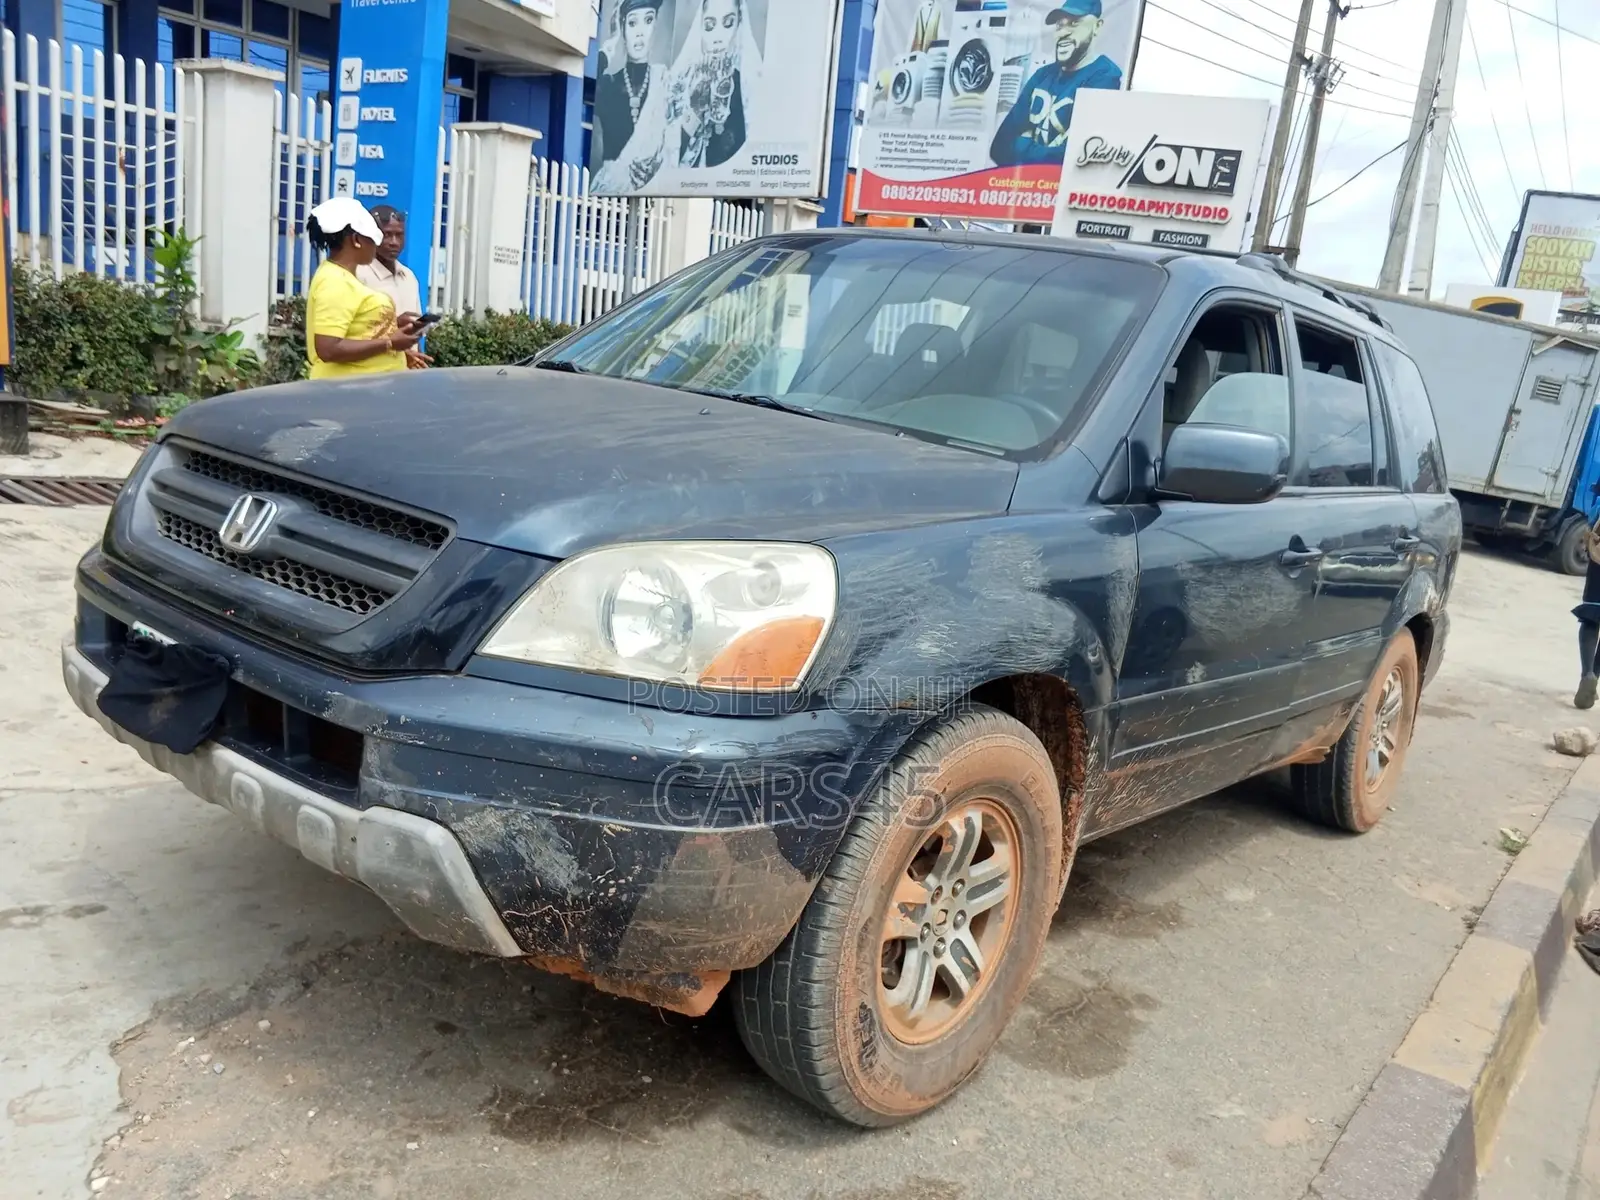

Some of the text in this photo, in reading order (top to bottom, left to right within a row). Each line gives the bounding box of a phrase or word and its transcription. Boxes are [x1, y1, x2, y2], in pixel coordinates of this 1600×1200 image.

[360, 107, 397, 122] HOTEL
[358, 144, 385, 159] VISA
[751, 154, 799, 165] STUDIOS
[356, 182, 389, 197] RIDES
[988, 176, 1035, 189] Customer
[881, 184, 976, 206] 08032039631,
[1080, 222, 1127, 238] PORTRAIT
[1159, 232, 1203, 246] FASHION
[1520, 254, 1580, 276] BISTRO
